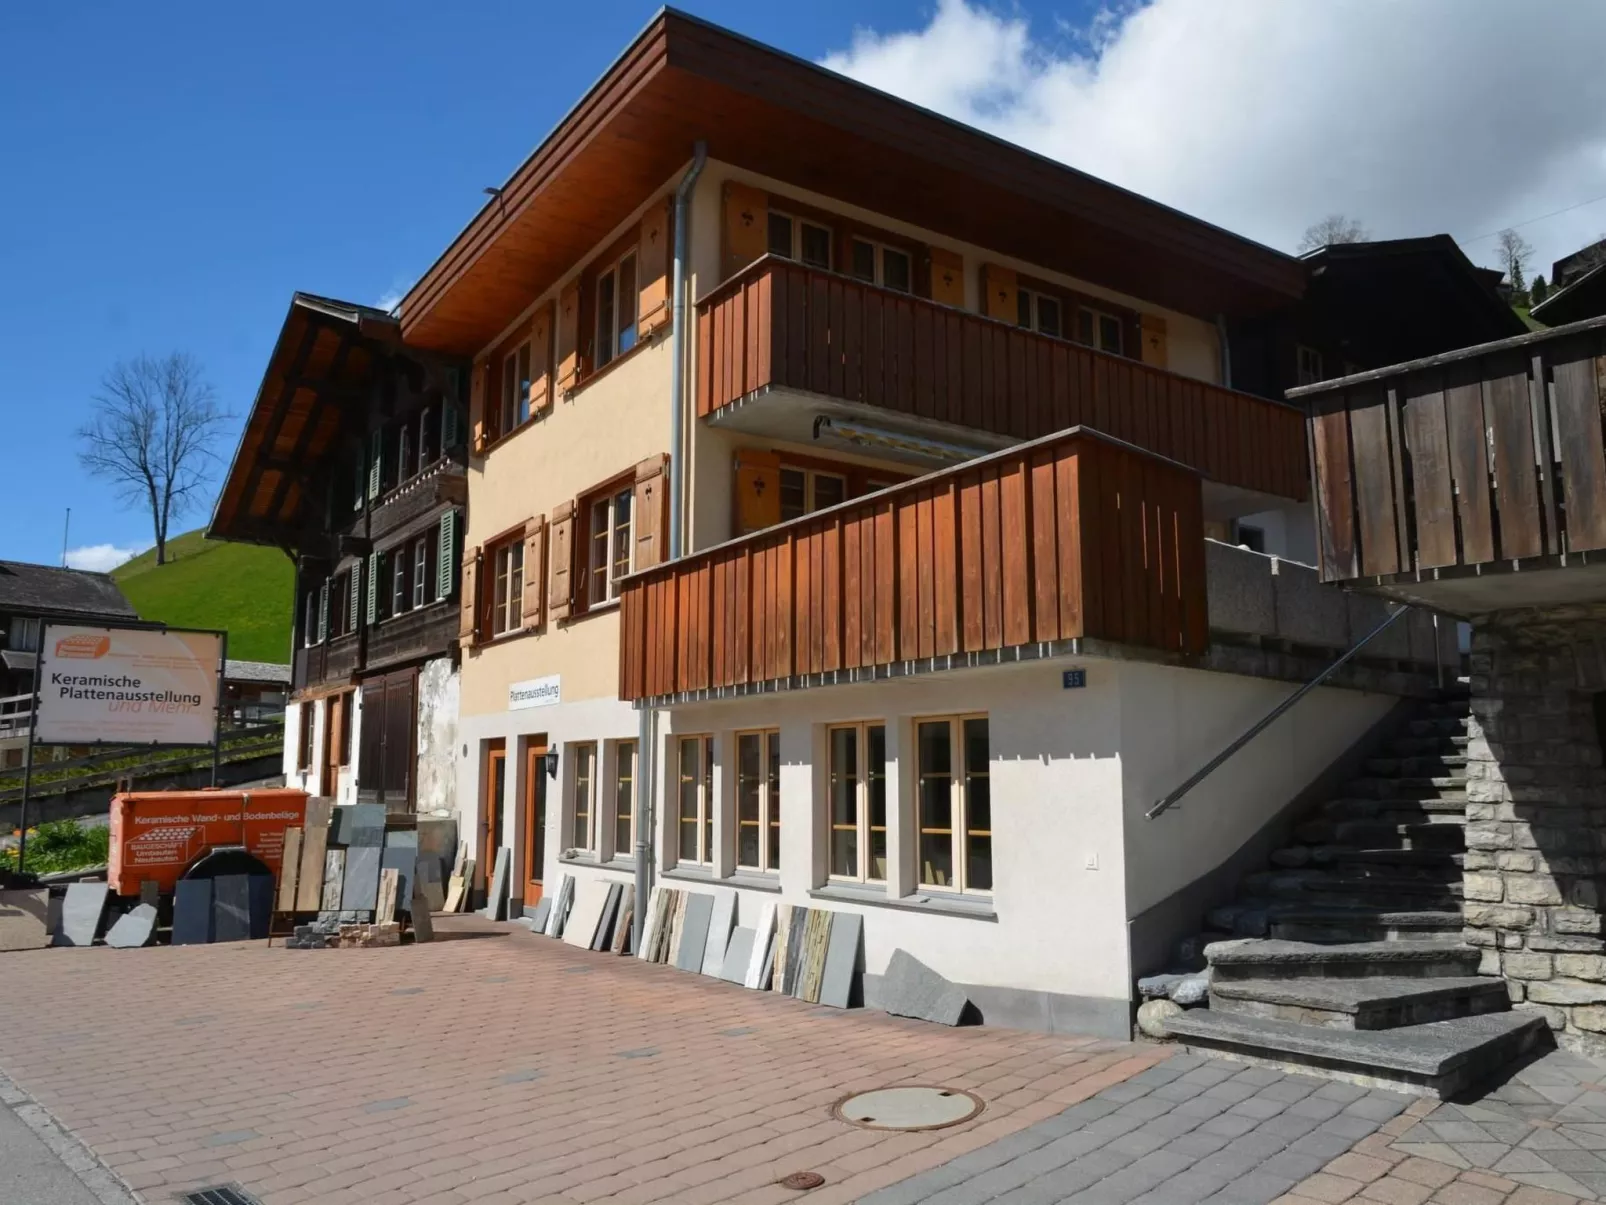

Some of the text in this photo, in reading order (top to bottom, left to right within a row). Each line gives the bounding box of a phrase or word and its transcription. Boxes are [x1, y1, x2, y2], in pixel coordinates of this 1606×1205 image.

[51, 673, 141, 688] Keramische
[59, 687, 201, 706] Plattenausstellung
[510, 684, 559, 701] Plattenausstellung
[108, 700, 142, 713] und
[134, 814, 189, 825] Keramische
[223, 812, 241, 821] und
